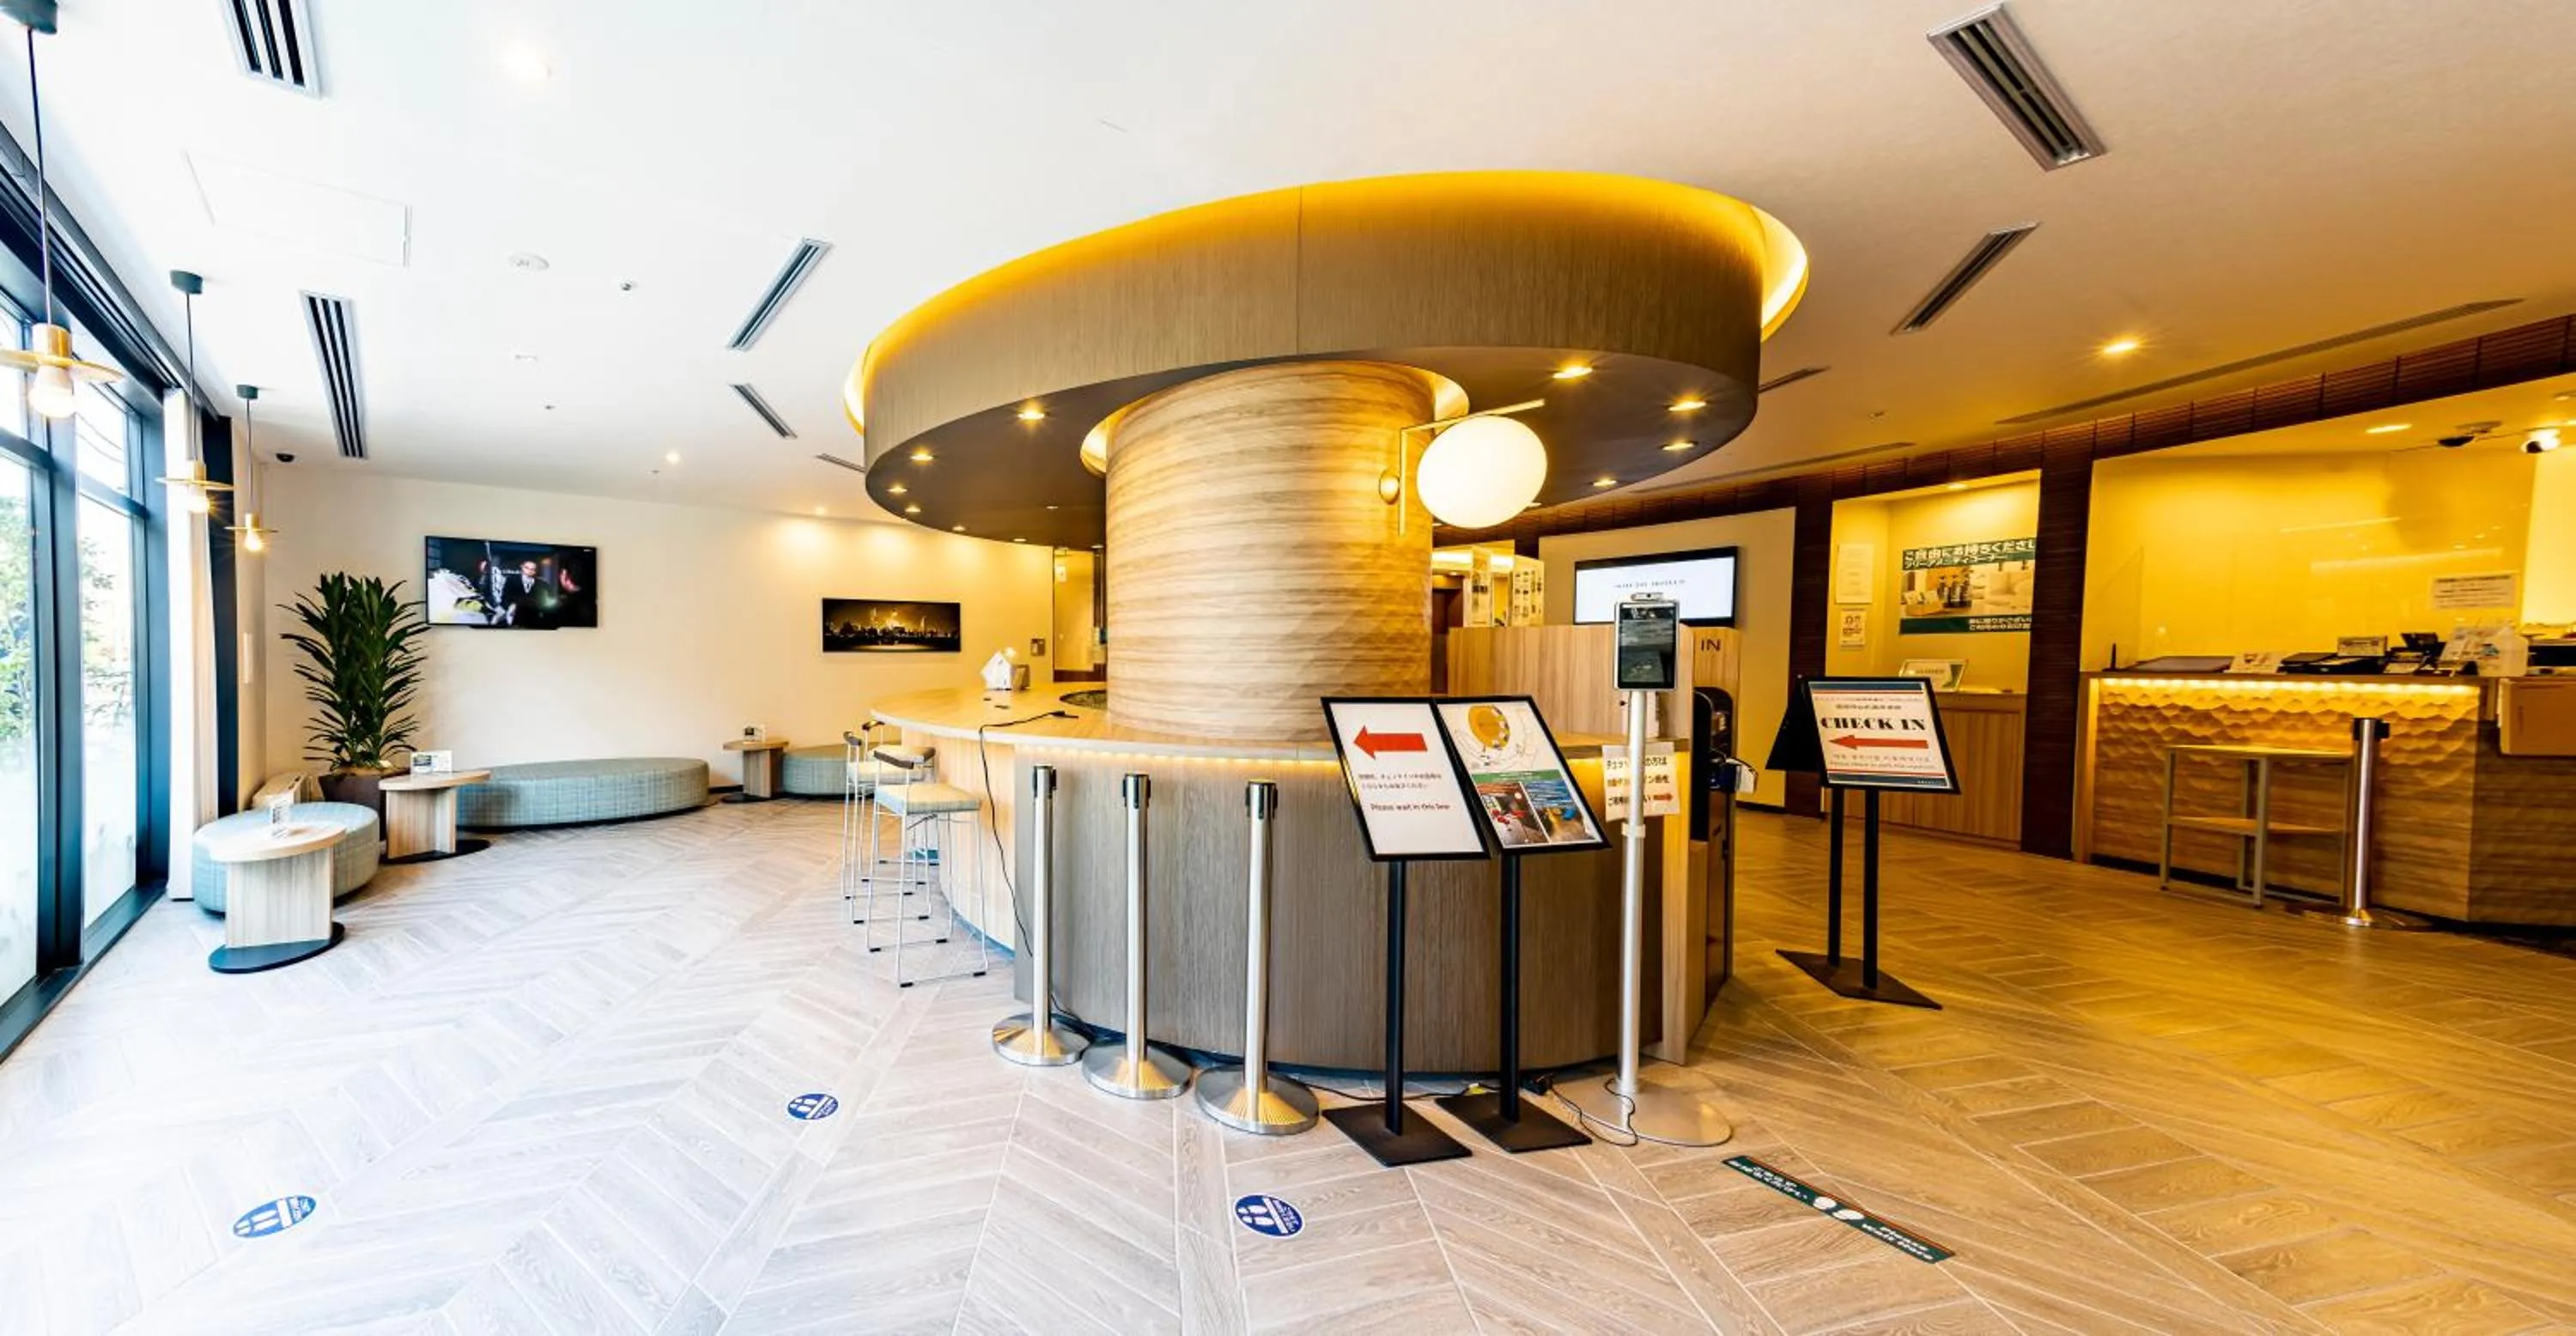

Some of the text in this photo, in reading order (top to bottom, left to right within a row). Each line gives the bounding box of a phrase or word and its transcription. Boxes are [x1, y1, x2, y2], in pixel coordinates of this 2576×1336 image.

[1701, 639, 1721, 652] IN
[1820, 717, 1926, 731] CHECK IN
